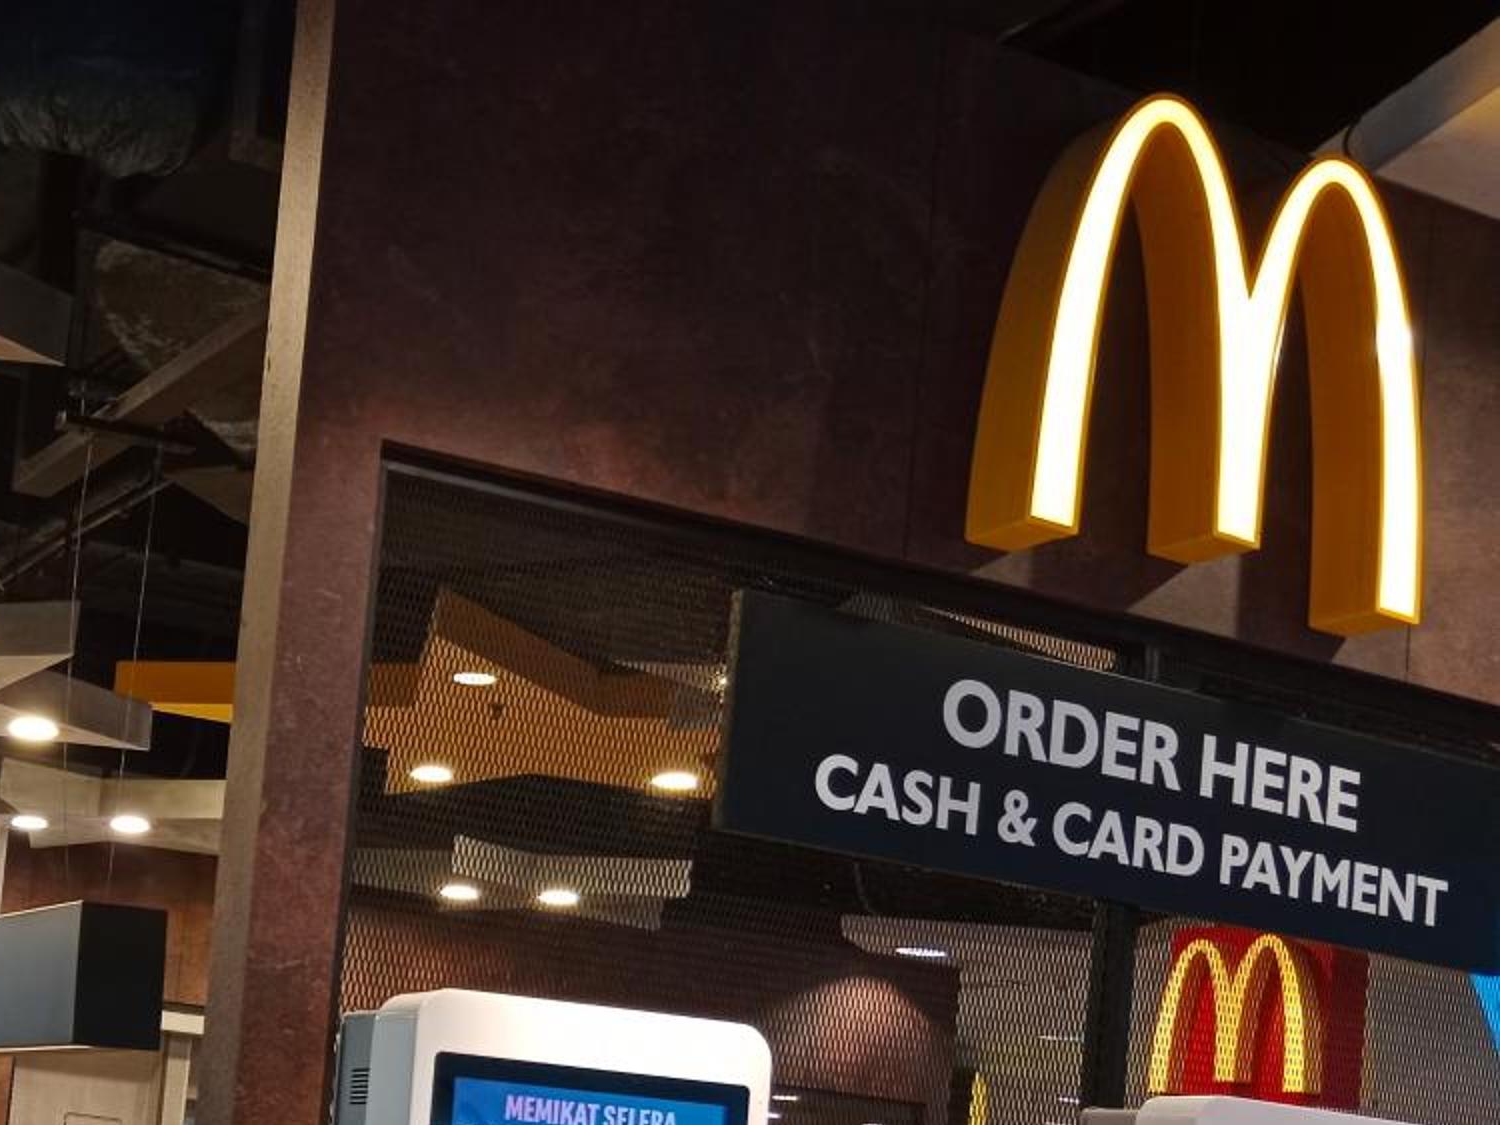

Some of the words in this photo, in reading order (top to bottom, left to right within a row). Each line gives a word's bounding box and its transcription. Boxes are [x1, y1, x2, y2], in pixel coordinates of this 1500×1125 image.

[942, 678, 1181, 792] ORDER
[1199, 733, 1362, 833] HERE
[814, 753, 982, 836] CASH
[997, 789, 1037, 847] &
[1052, 800, 1204, 878] CARD
[1219, 833, 1449, 928] PAYMENT
